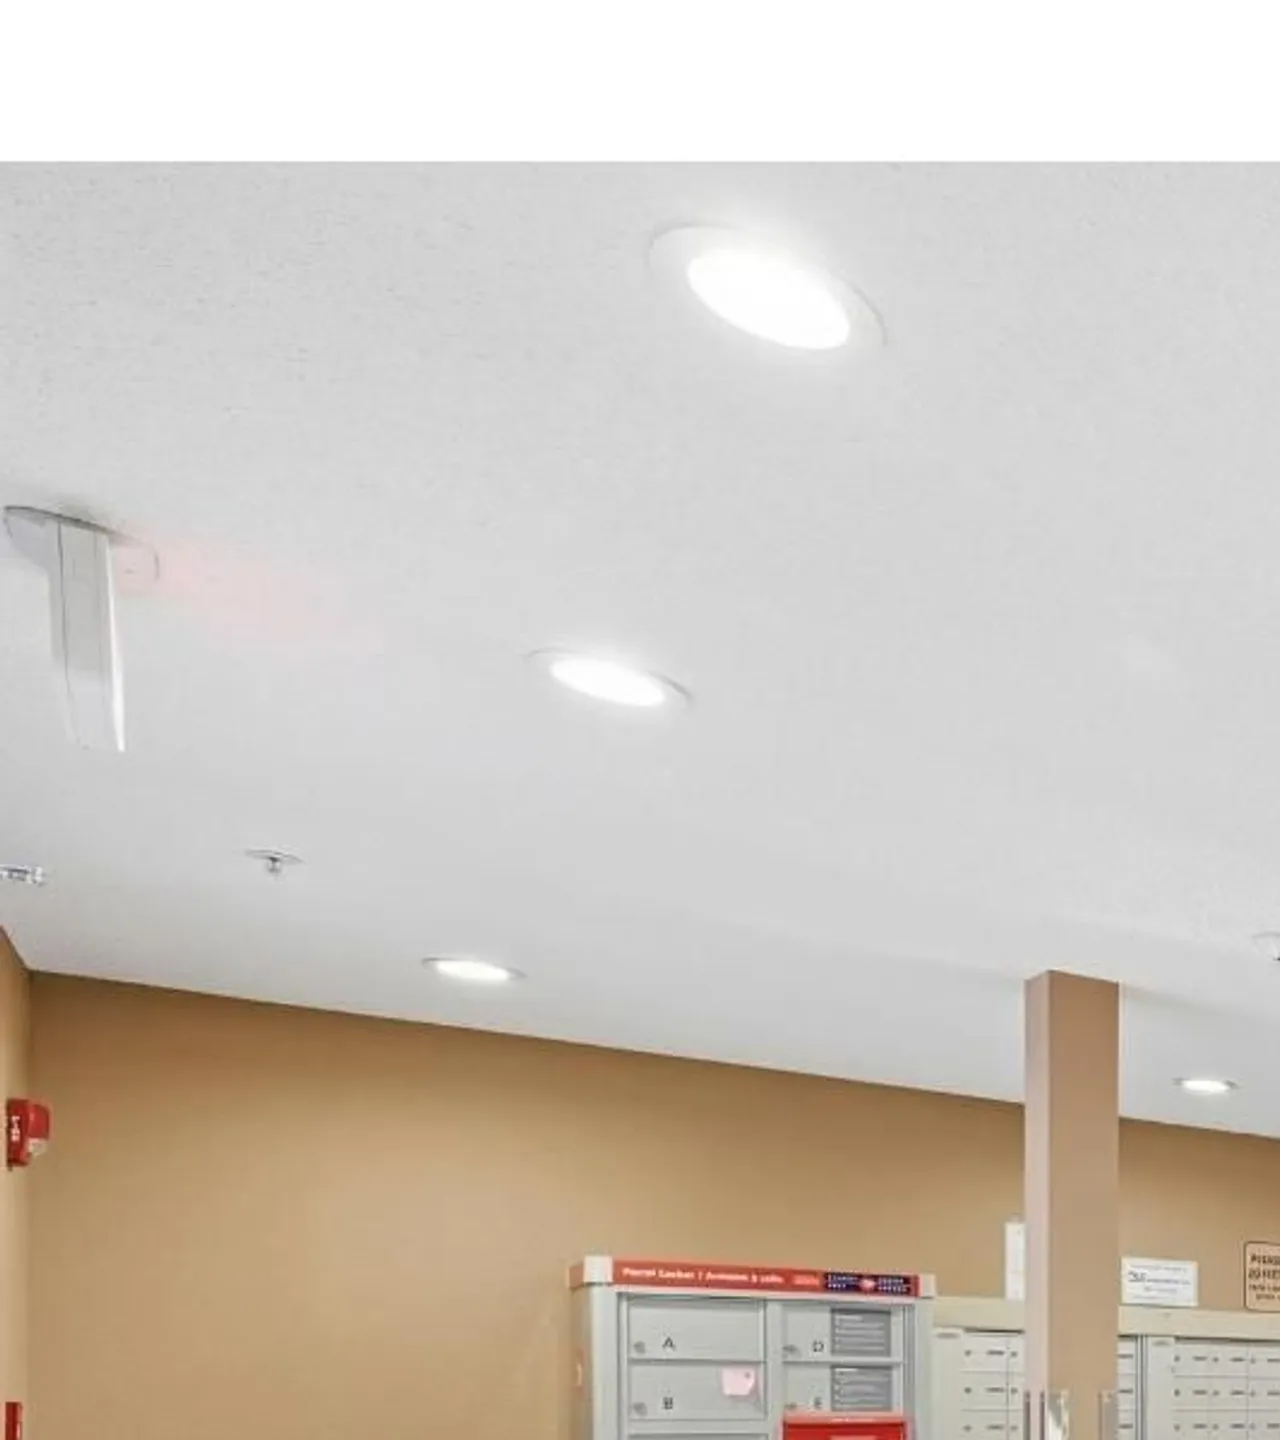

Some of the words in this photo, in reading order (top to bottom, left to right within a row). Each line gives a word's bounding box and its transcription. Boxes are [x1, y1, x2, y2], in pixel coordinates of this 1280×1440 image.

[662, 1337, 676, 1350] A
[812, 1341, 824, 1353] D
[662, 1397, 674, 1410] B
